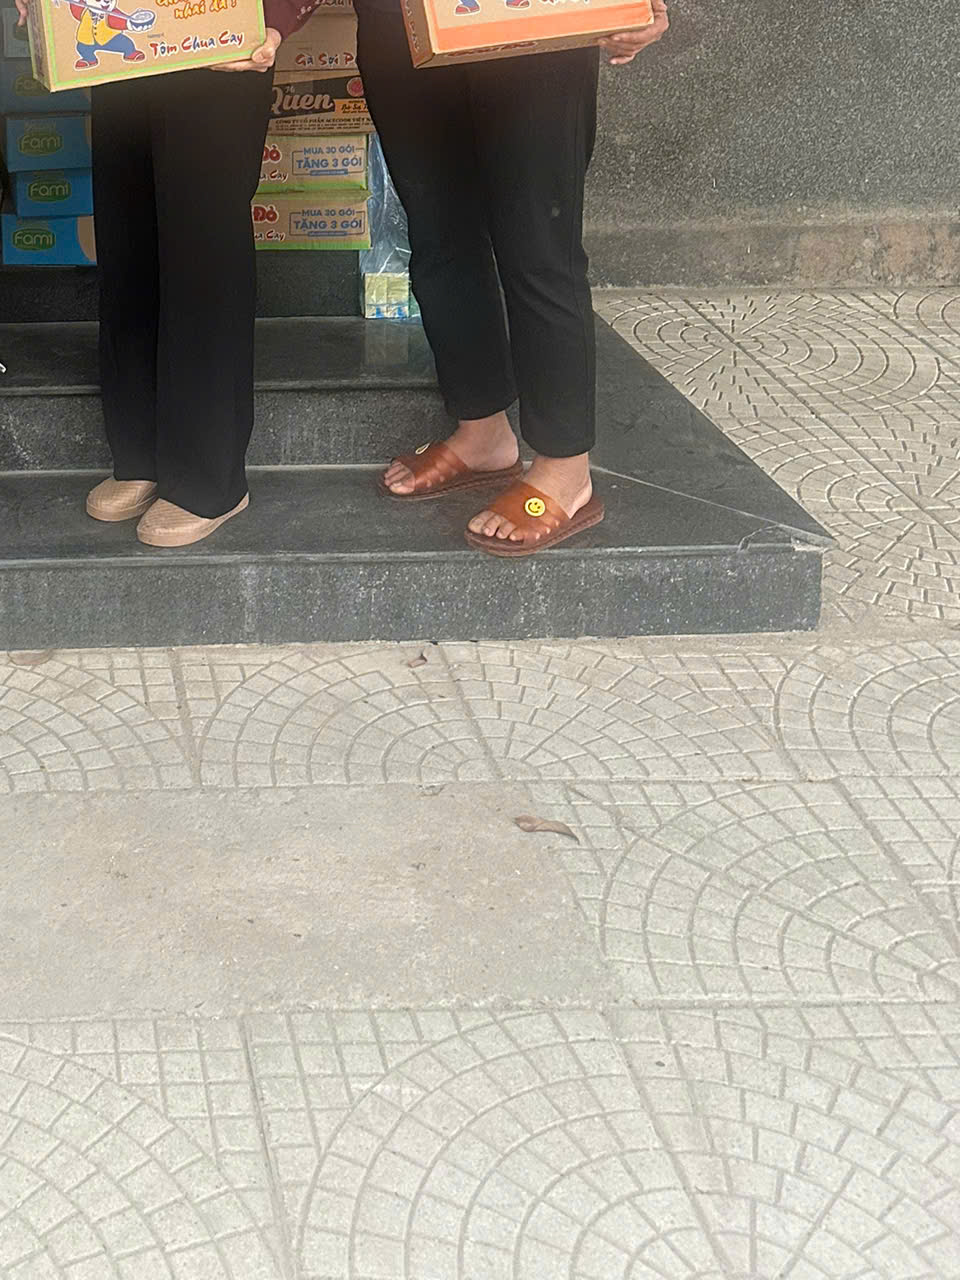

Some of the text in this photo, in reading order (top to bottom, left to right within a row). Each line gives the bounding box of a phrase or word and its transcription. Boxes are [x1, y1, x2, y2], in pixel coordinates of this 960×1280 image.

[150, 31, 243, 56] Tôm Chua Cay
[304, 144, 355, 155] MUA 30 GÓI
[296, 155, 362, 171] TẶNG 3 GÓI
[29, 182, 69, 197] Fami
[301, 208, 355, 217] MUA 30 GÓI
[293, 217, 362, 232] TẶNG 3 GÓI
[14, 231, 53, 246] Fami
